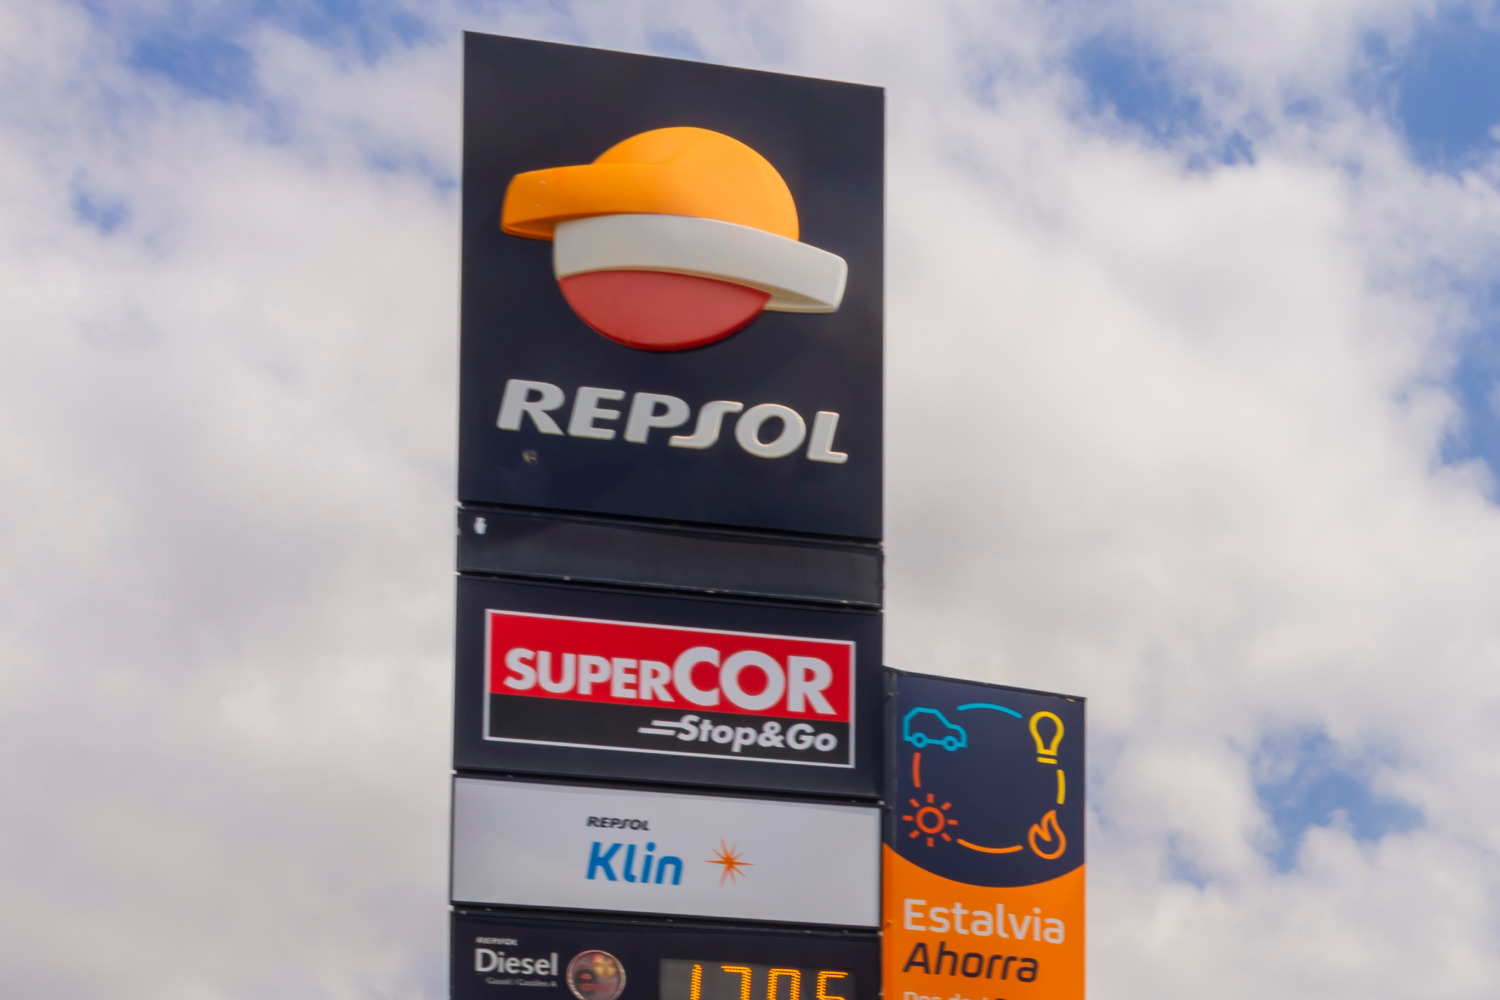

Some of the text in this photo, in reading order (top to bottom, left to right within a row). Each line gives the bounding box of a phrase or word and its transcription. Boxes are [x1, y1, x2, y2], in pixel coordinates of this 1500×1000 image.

[496, 379, 849, 464] REPSOL
[503, 646, 838, 716] SUPERCOR
[674, 714, 838, 753] Stop&Go
[586, 816, 650, 831] REPSOL
[586, 841, 683, 886] Klin
[904, 898, 1065, 944] Estalvia
[474, 948, 559, 976] Diesel
[902, 941, 1039, 983] Ahorra
